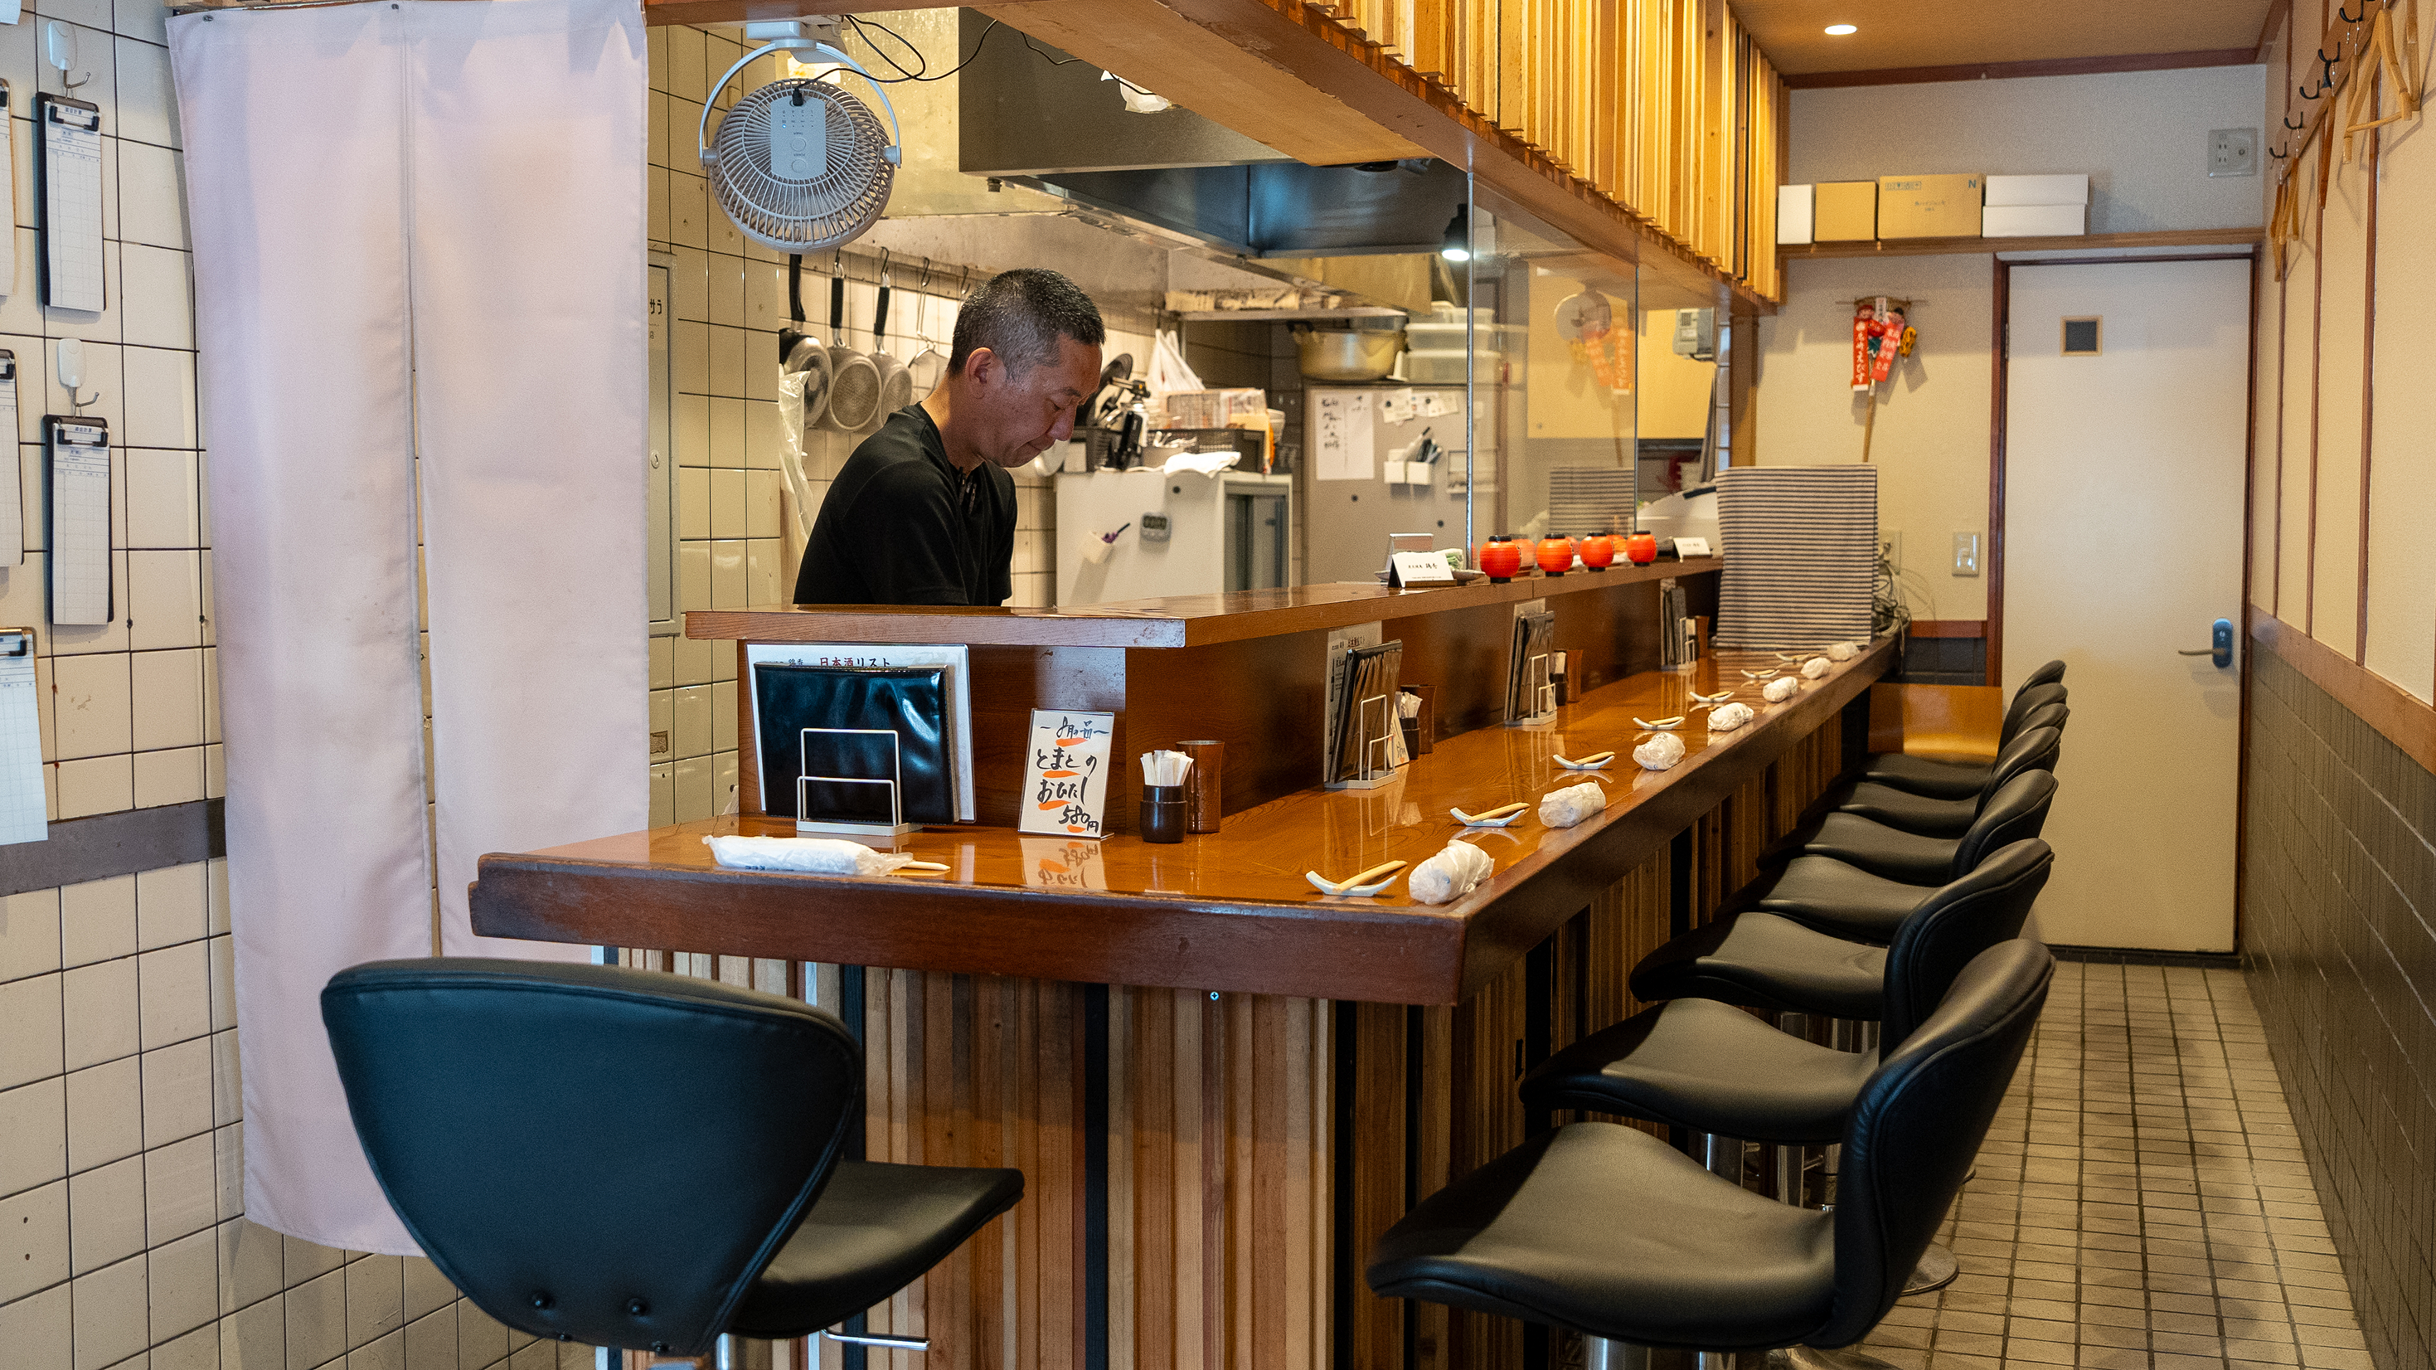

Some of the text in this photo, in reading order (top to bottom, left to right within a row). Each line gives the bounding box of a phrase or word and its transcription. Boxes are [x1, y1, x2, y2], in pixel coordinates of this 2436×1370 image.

[1968, 179, 1977, 189] N
[819, 656, 891, 667] 日本酒リスト
[1036, 776, 1086, 806] おひたし
[1058, 805, 1100, 833] 580円
